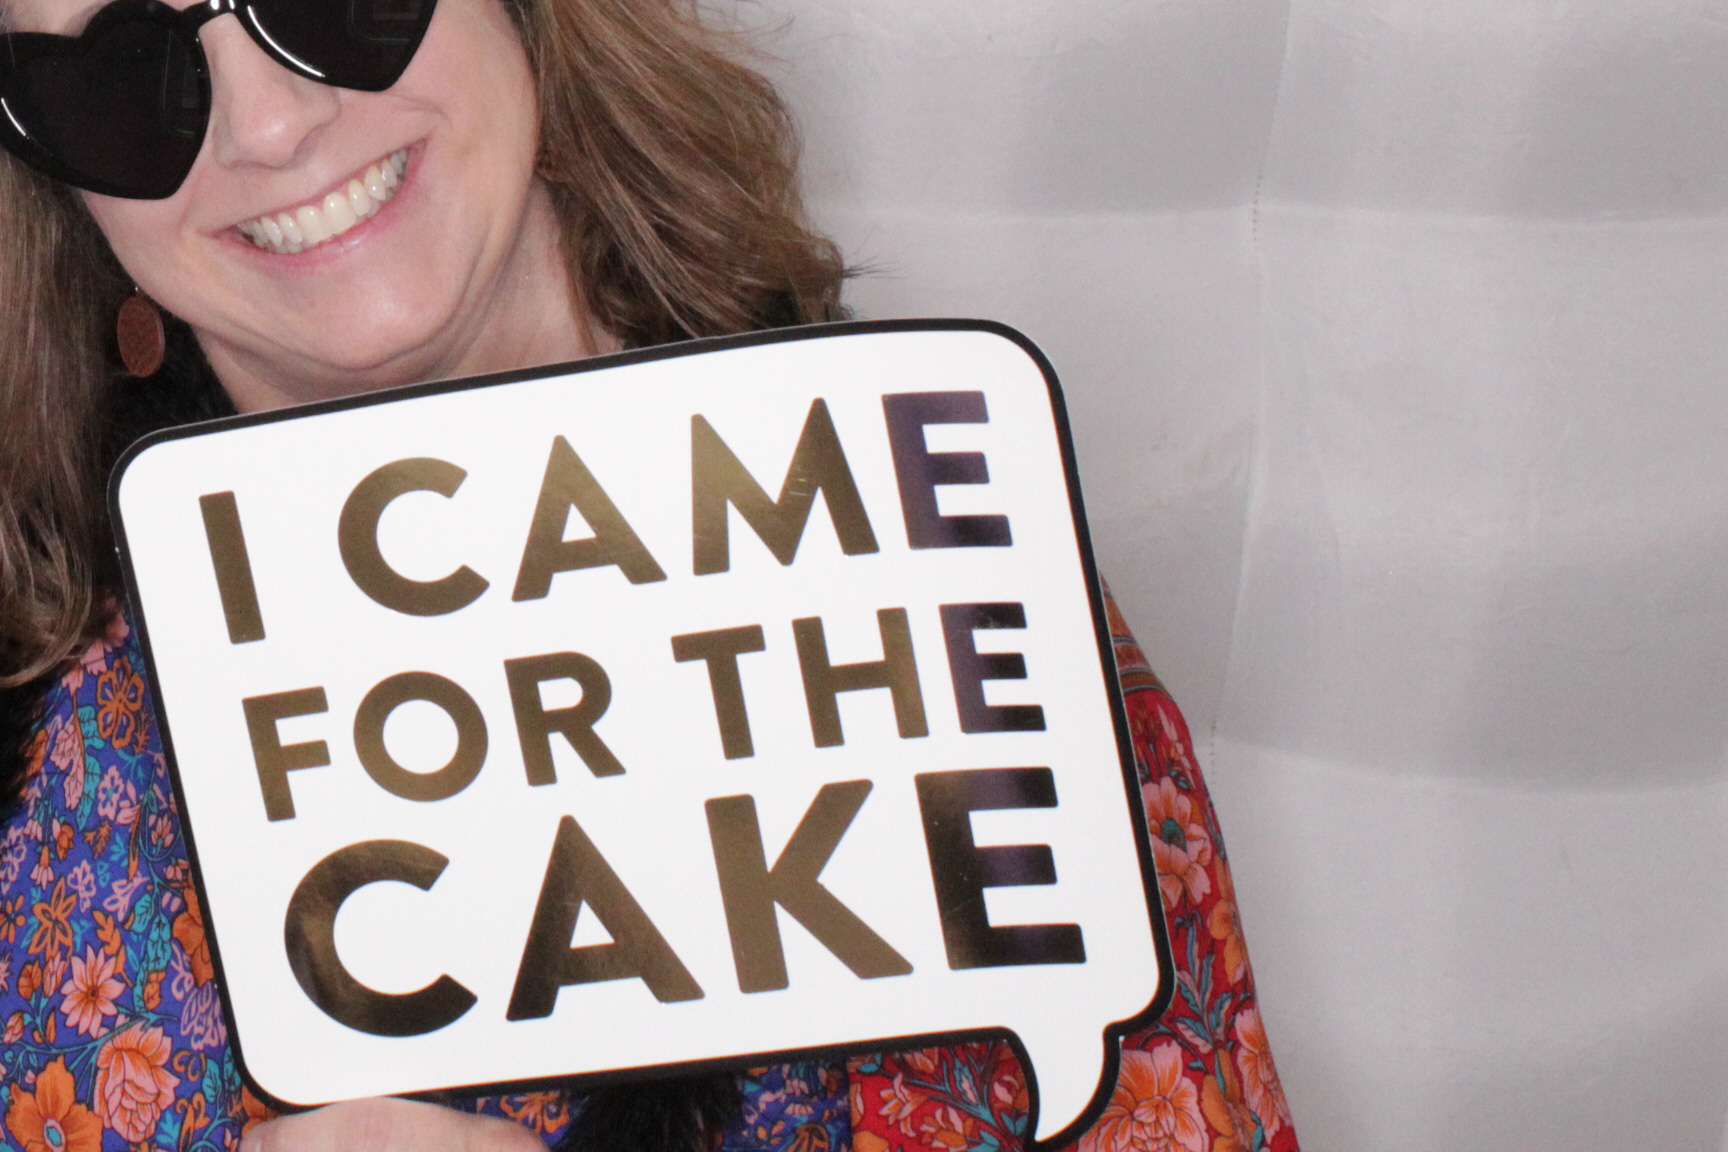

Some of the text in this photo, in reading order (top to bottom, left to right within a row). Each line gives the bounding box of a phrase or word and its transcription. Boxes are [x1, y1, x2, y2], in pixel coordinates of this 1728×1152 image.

[198, 390, 1013, 644] I CAME
[242, 601, 1046, 821] FOR THE
[283, 766, 1086, 1037] CAKE
